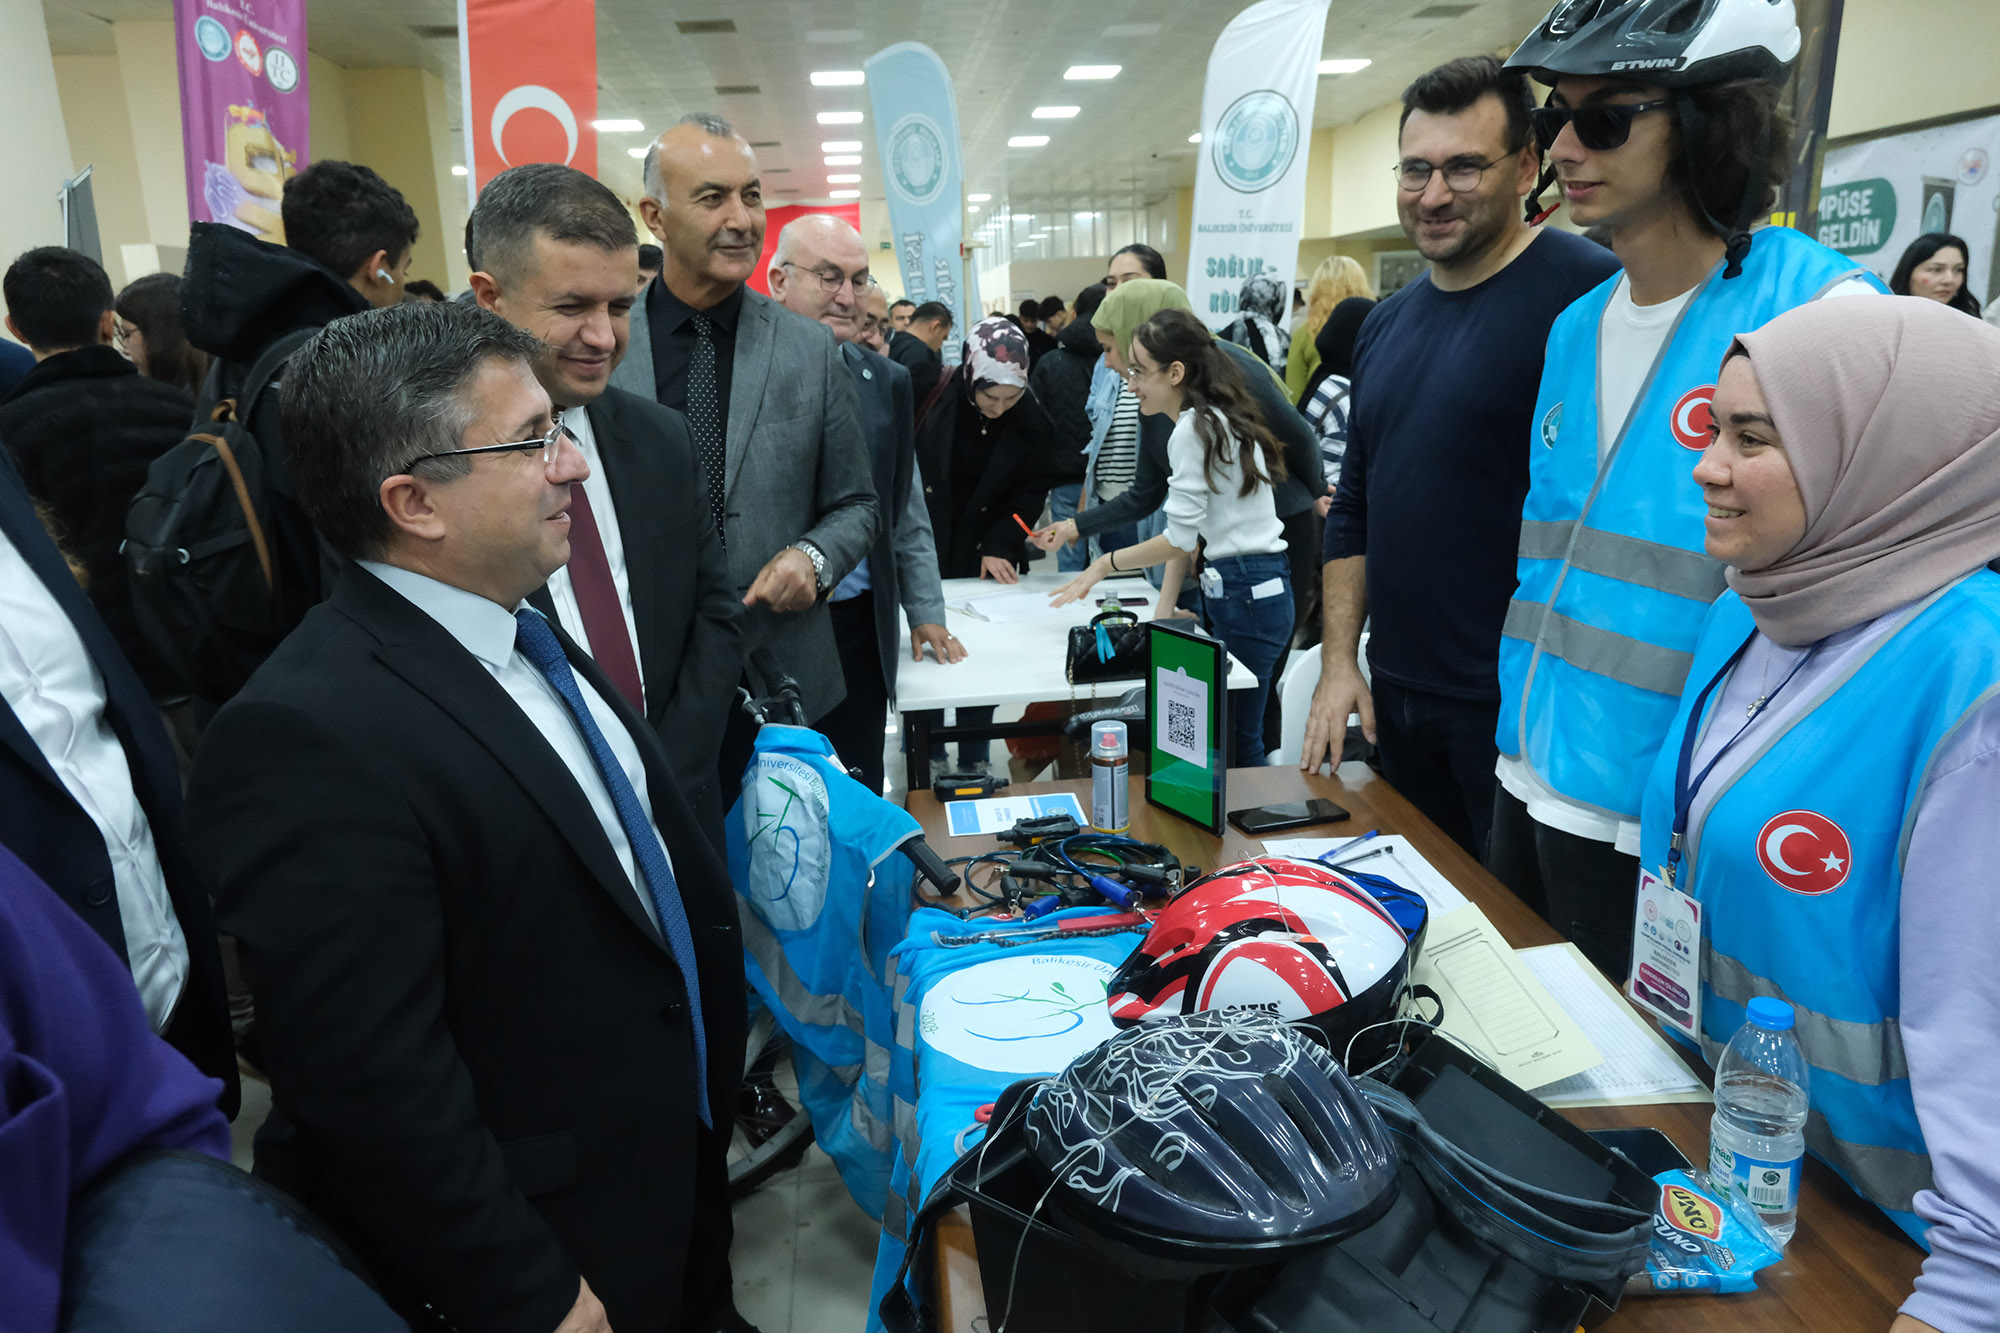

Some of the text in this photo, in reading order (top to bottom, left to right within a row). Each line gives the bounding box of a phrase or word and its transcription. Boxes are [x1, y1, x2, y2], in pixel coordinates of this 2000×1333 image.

[1209, 290, 1241, 314] KÜL
[759, 757, 815, 781] niversitesi
[1672, 1189, 1707, 1229] UNO
[1653, 1213, 1701, 1253] SUNO
